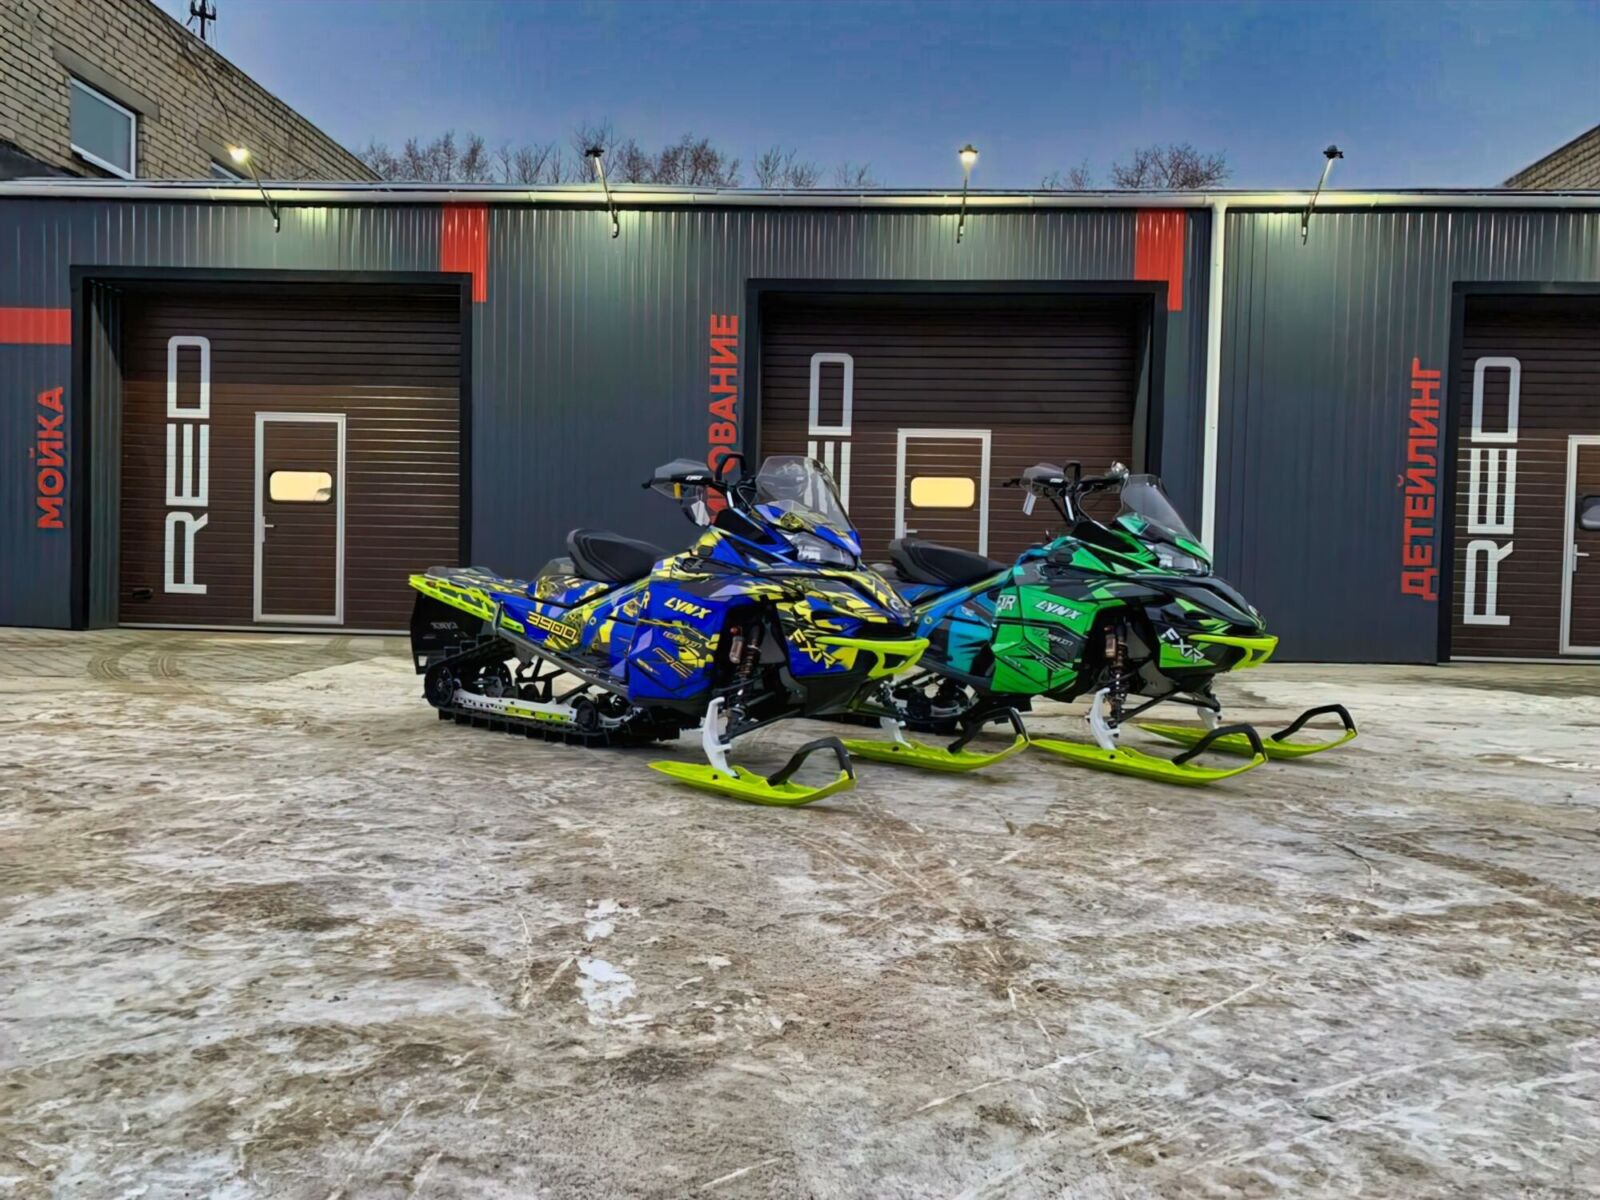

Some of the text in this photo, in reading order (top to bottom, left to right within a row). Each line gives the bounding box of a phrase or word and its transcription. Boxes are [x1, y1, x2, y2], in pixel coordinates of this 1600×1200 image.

[30, 386, 64, 530] МОЙКА
[164, 335, 211, 594] RED
[1397, 356, 1442, 601] ДЕТЕЙЛИНГ
[1463, 356, 1521, 626] RED
[664, 596, 712, 620] LYNX
[1035, 600, 1083, 620] LYNX
[1160, 627, 1205, 663] FXR
